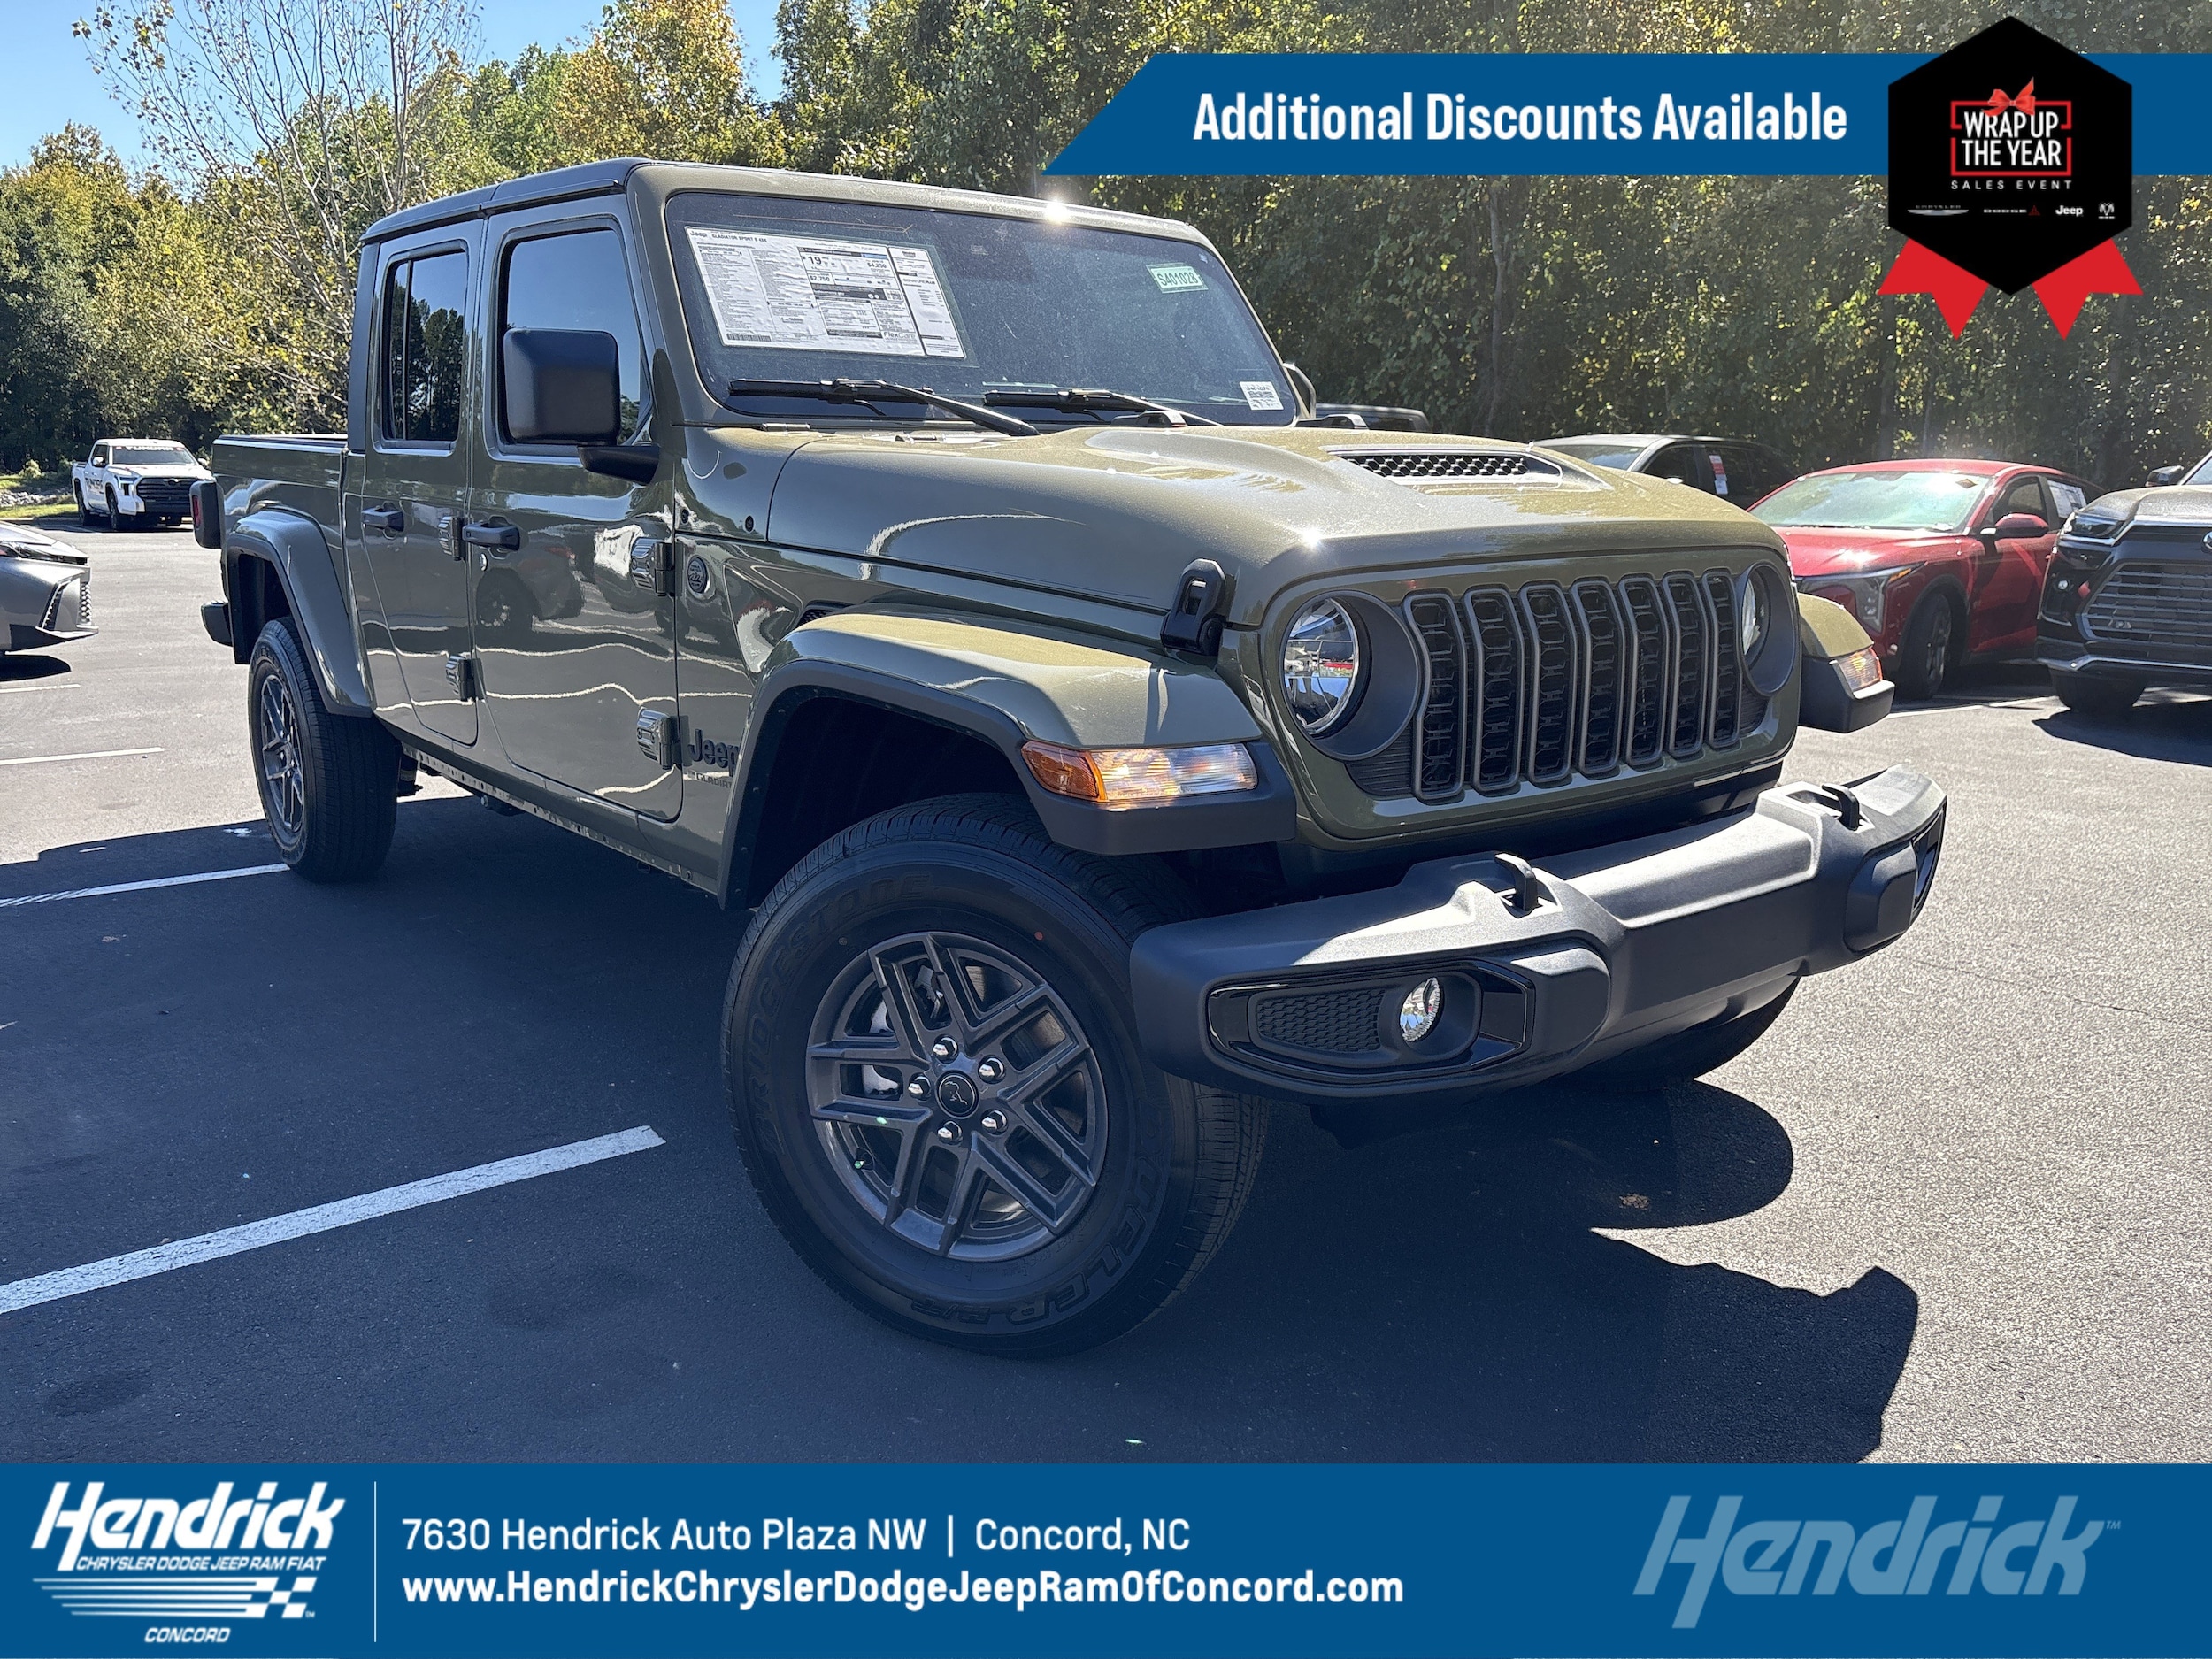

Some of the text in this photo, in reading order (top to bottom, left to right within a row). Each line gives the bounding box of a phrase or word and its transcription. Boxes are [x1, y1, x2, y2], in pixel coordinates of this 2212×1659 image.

[809, 256, 822, 265] 19
[1156, 272, 1199, 286] S401028
[687, 728, 740, 778] Jeep
